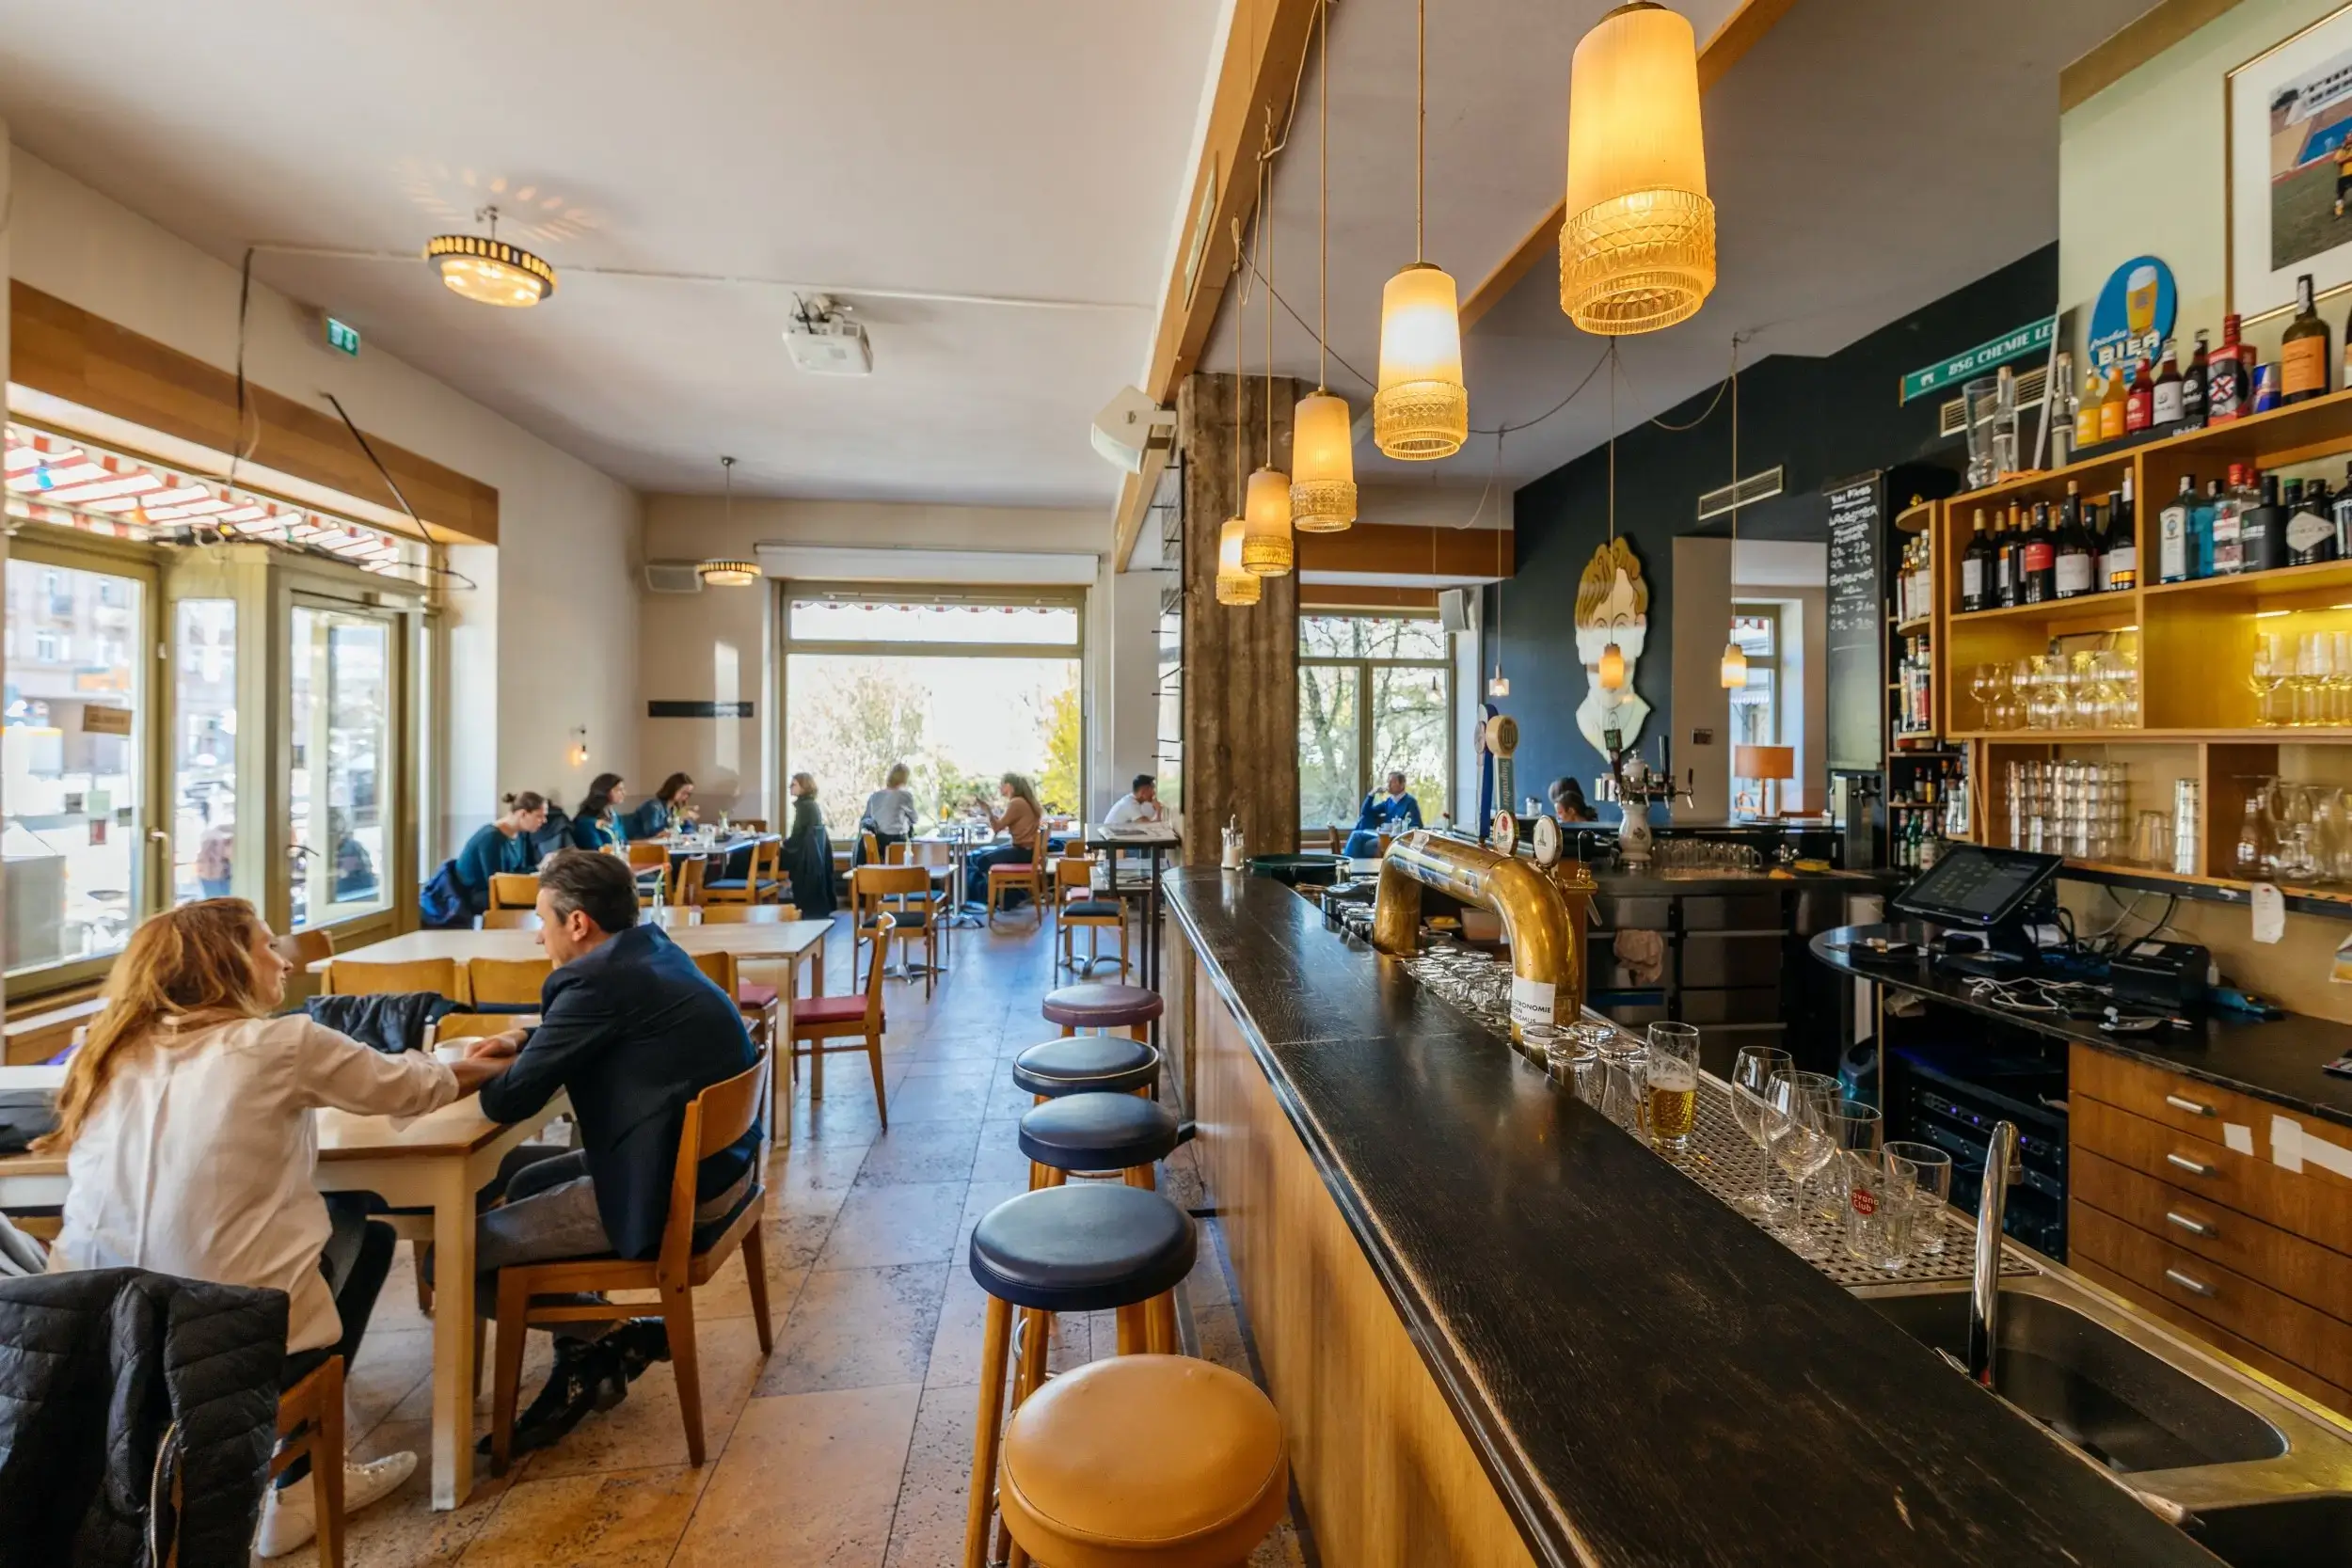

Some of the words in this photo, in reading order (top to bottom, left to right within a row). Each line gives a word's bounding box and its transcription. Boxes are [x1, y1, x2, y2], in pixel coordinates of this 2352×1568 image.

[1948, 357, 1974, 376] BSG
[1977, 331, 2030, 365] CHEMIE
[2098, 330, 2162, 367] BIER
[1852, 1192, 1880, 1206] avana
[1853, 1199, 1872, 1212] Club
